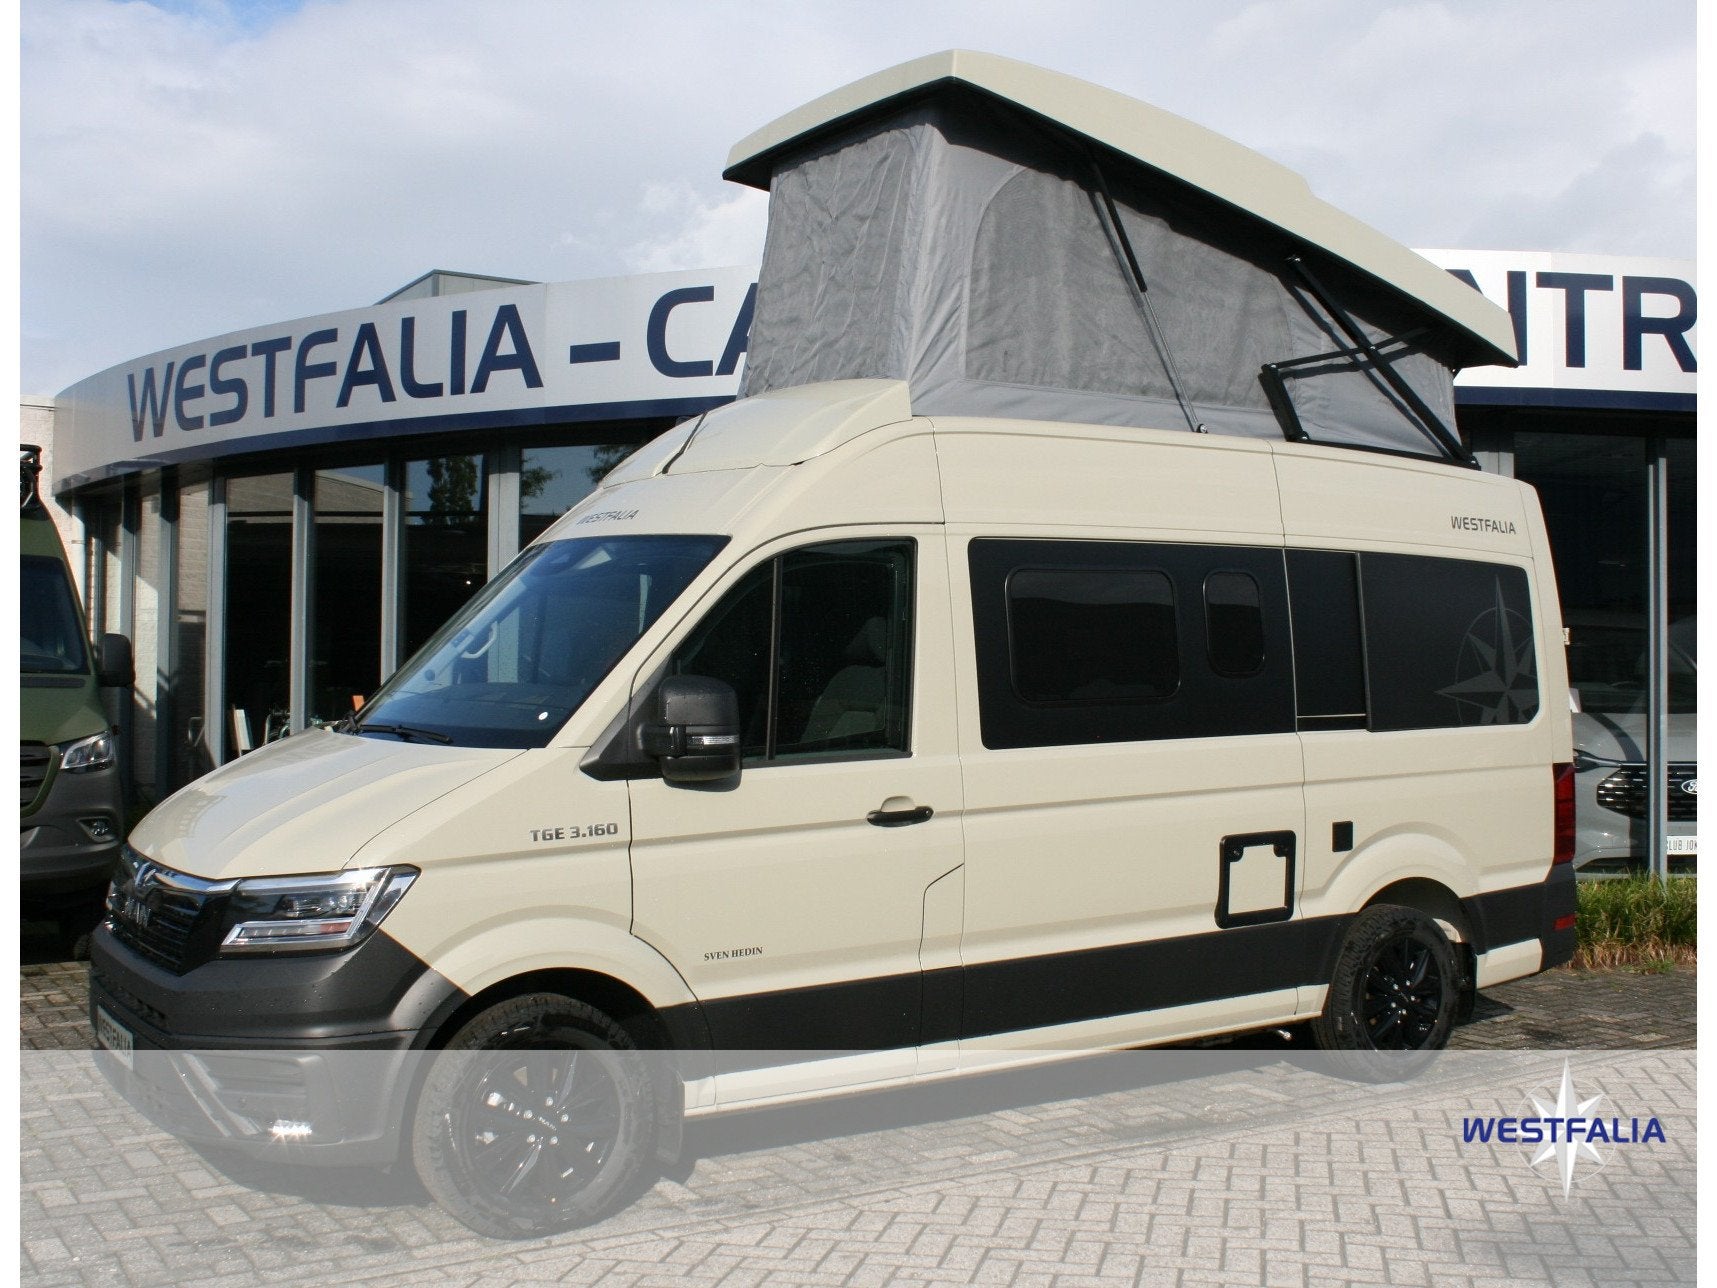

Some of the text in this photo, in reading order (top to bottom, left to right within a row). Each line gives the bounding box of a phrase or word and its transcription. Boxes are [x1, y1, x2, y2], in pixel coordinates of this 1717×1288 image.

[127, 304, 543, 442] WESTFALIA
[576, 509, 640, 526] WESTFALIA
[1450, 515, 1517, 535] WESTFALIA
[530, 822, 619, 842] TGE 3.160
[703, 947, 764, 961] SVEN HEDIN
